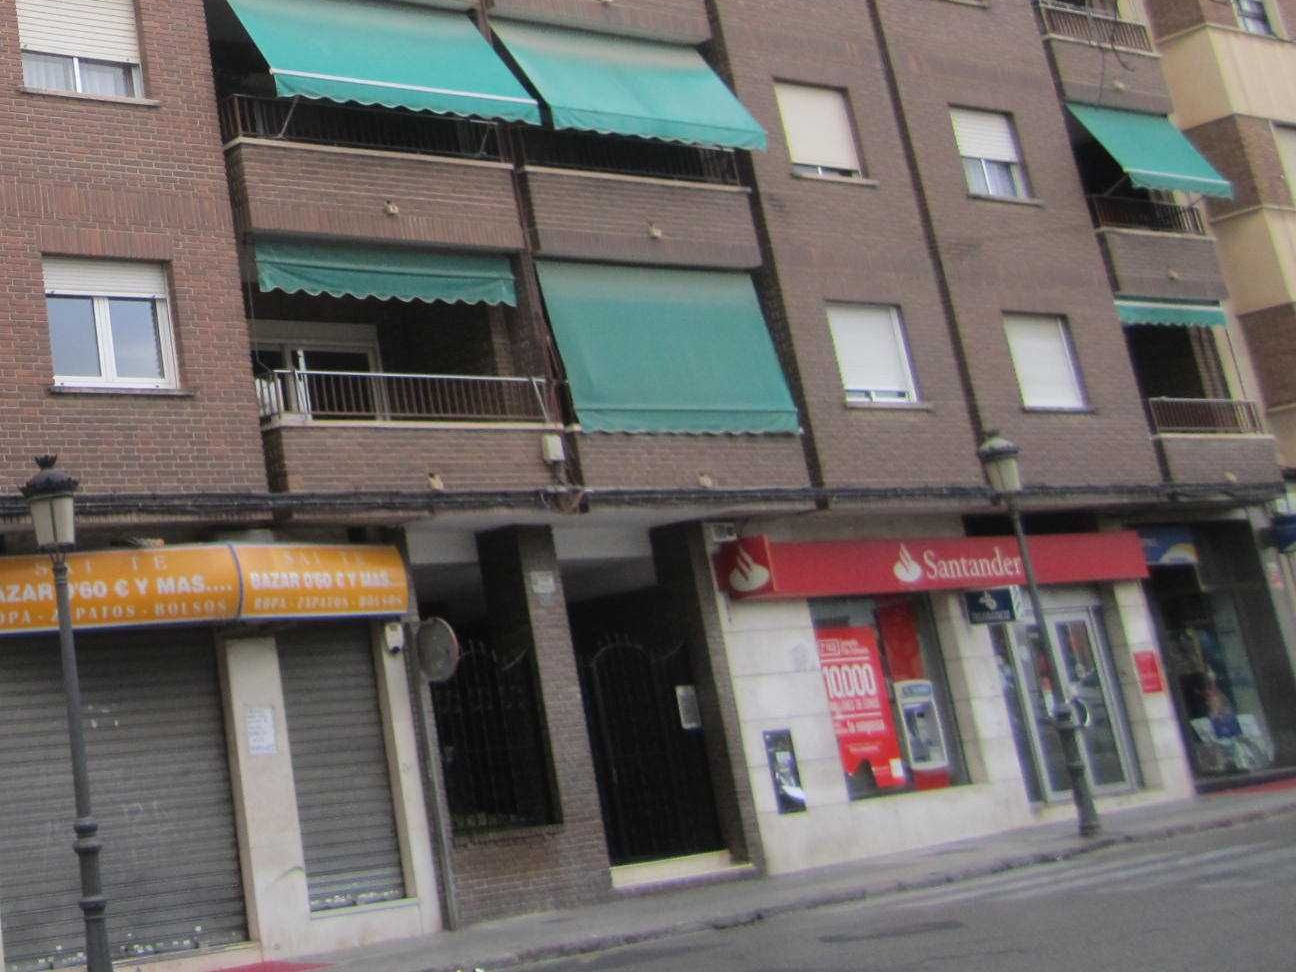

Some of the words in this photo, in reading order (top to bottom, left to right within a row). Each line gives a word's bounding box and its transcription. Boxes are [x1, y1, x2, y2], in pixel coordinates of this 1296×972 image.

[923, 545, 1024, 579] Santander
[115, 580, 129, 598] €
[134, 578, 149, 595] Y
[250, 571, 300, 590] BAZAR
[155, 599, 228, 616] BOLSOS
